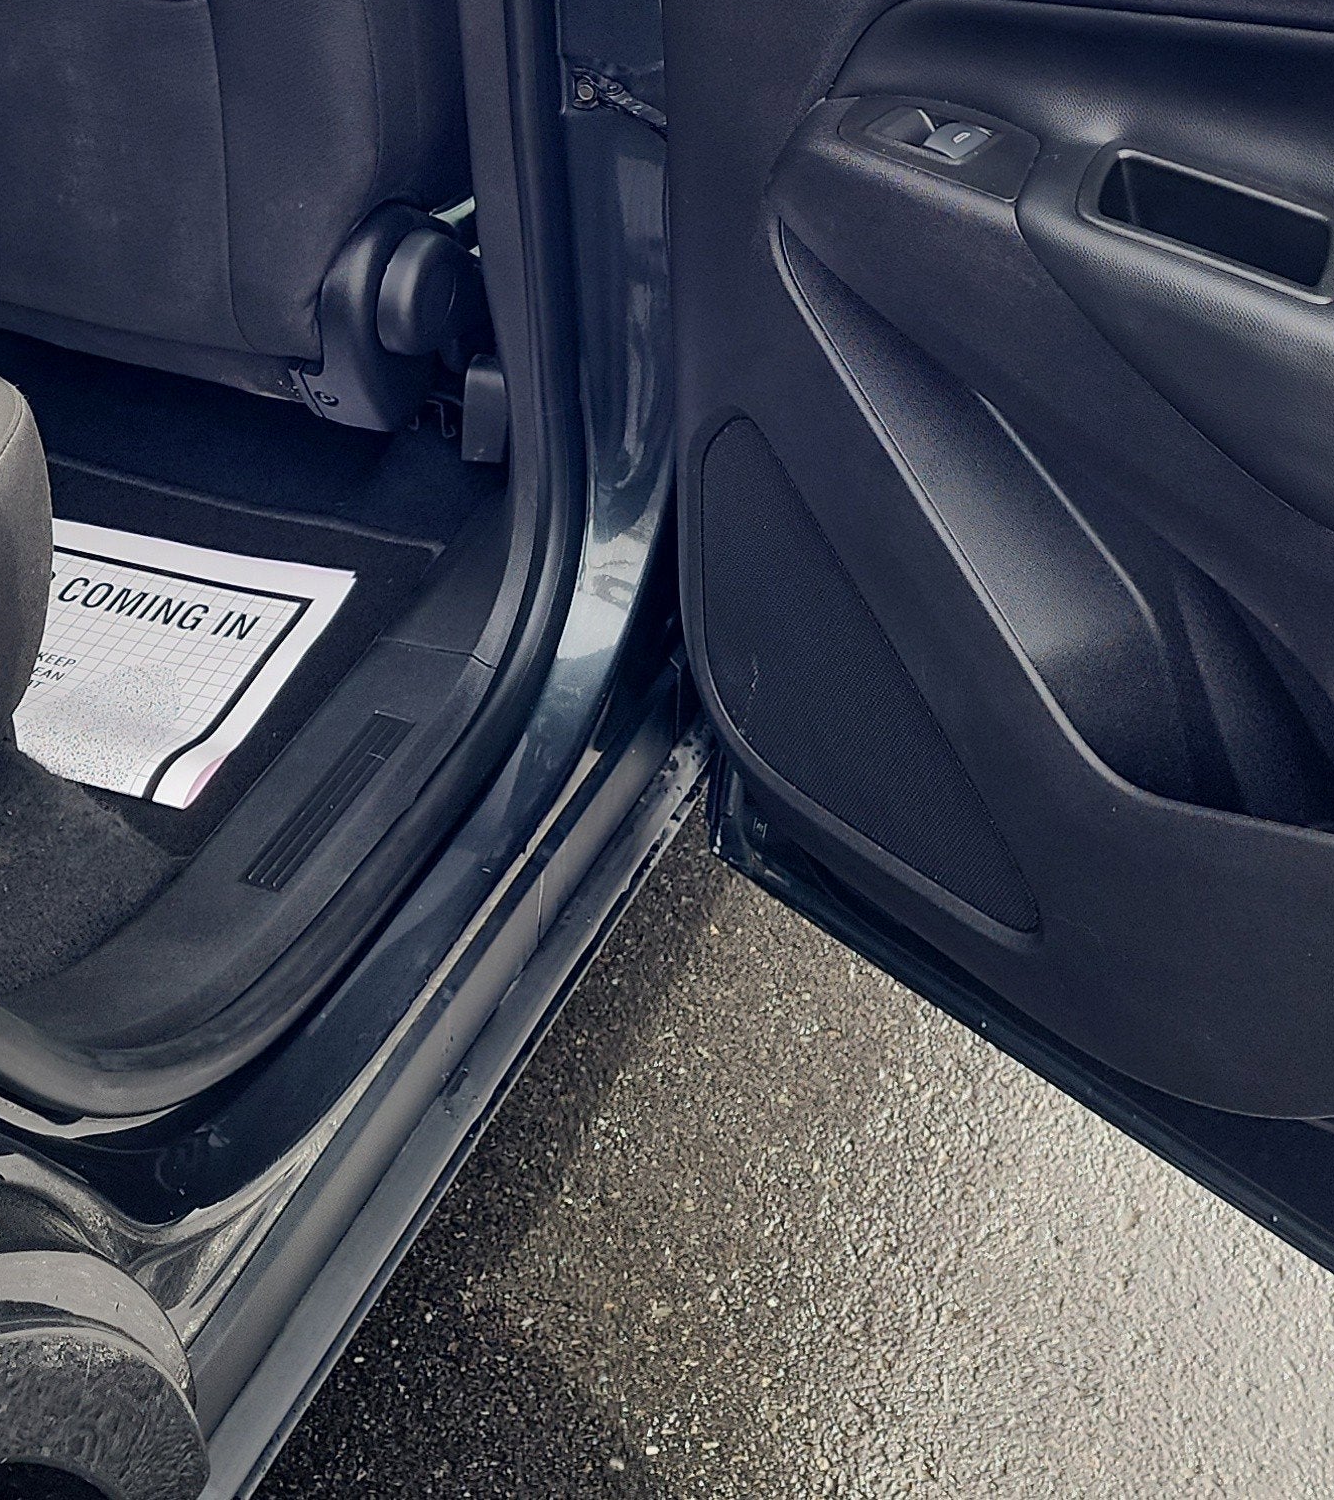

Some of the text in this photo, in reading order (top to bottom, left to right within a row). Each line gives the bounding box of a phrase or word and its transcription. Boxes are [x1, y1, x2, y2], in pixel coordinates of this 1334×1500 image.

[57, 577, 261, 641] COMING IN
[37, 651, 76, 668] KEEP
